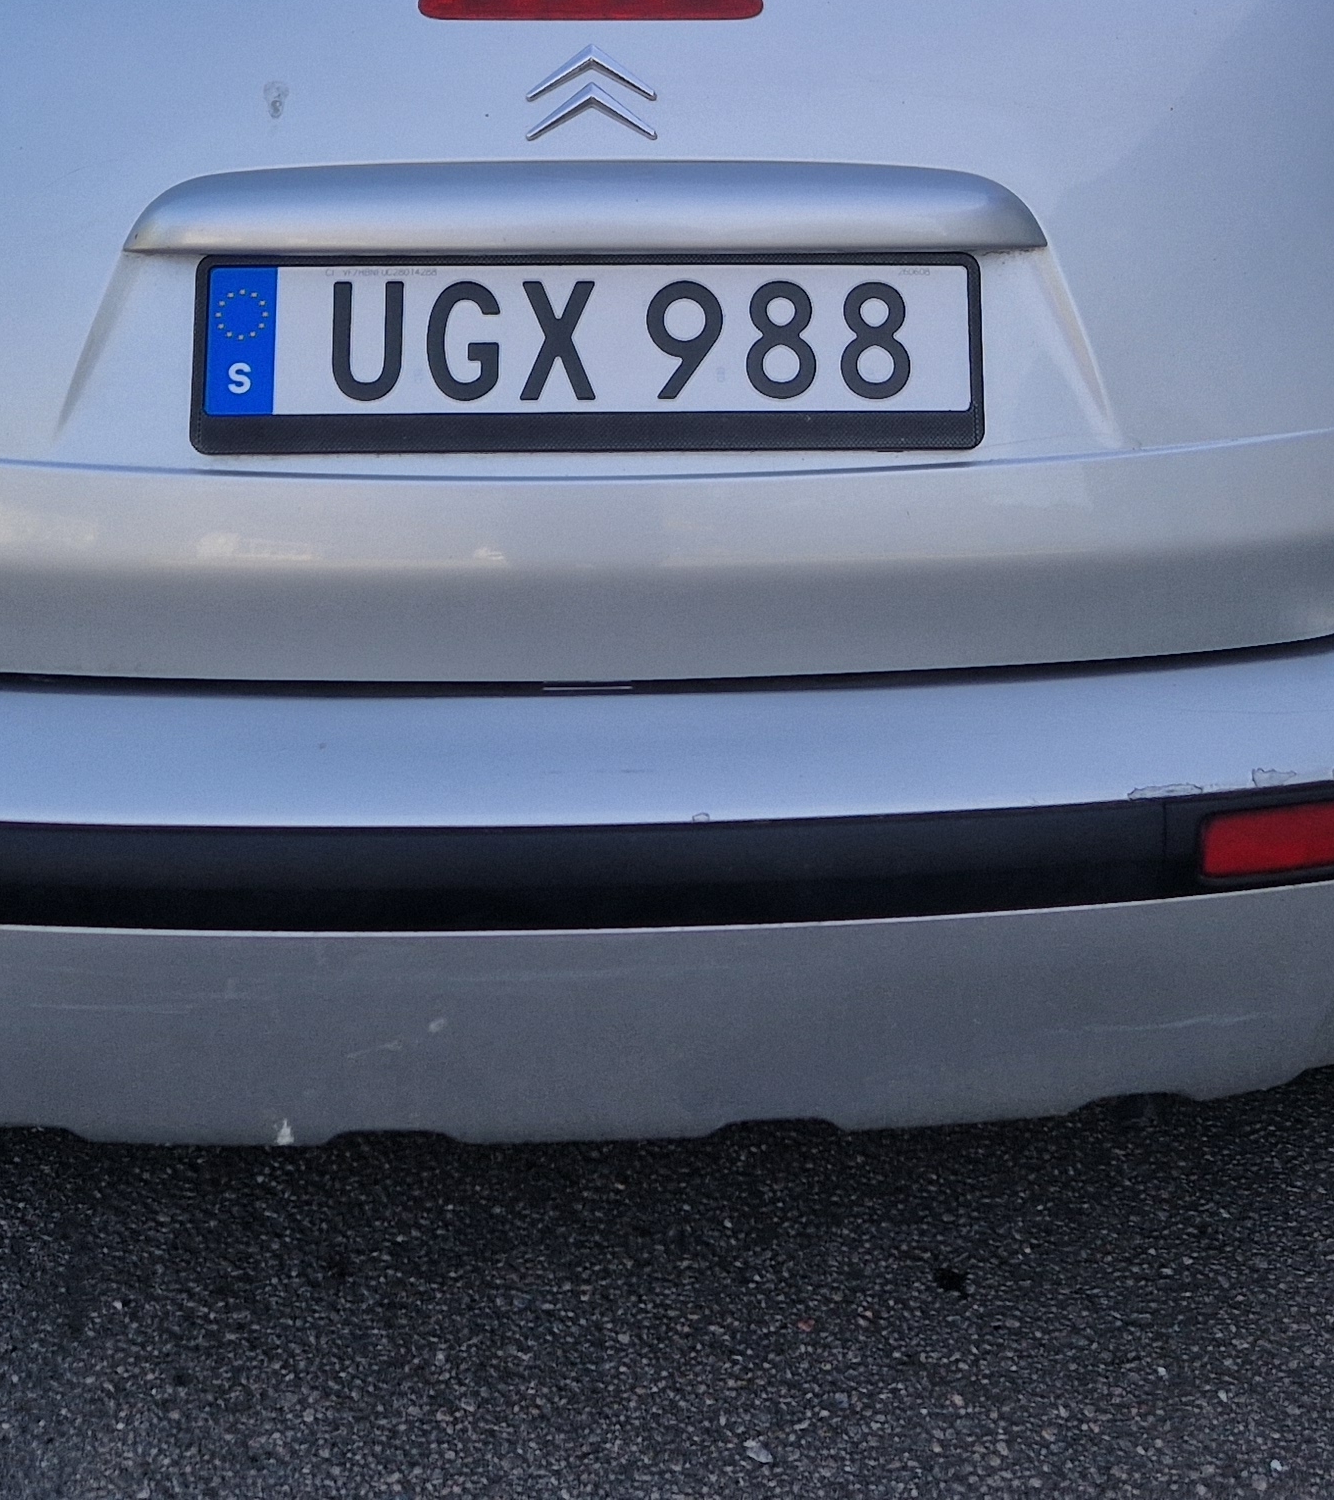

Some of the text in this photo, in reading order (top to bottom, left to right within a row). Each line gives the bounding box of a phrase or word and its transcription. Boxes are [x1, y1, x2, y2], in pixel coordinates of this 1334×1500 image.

[228, 362, 252, 394] S
[332, 280, 911, 401] UGX 988
